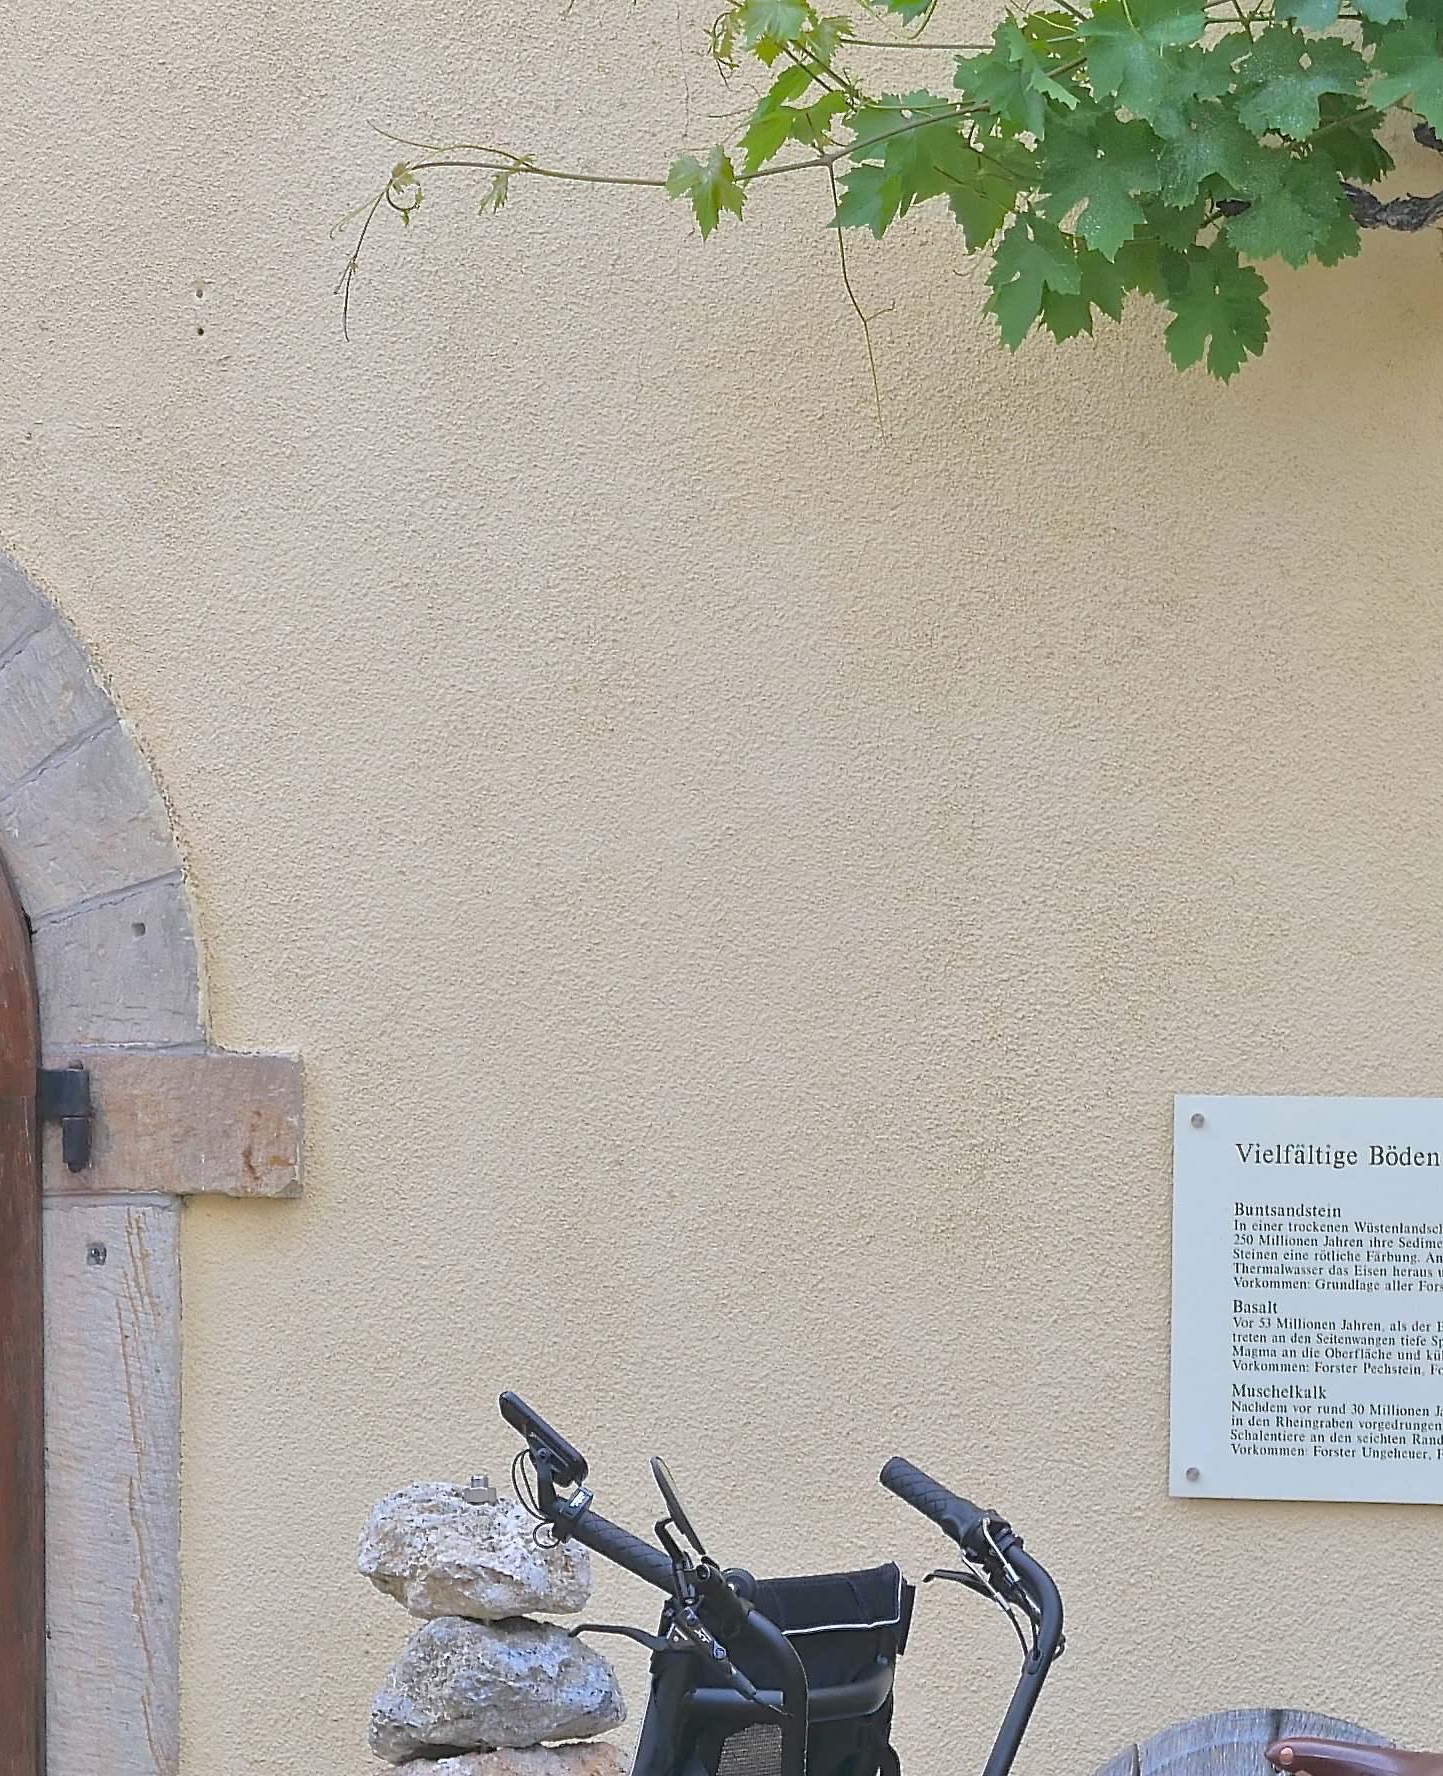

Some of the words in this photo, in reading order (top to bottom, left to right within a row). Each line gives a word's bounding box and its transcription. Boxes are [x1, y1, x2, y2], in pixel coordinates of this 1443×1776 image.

[1235, 1143, 1357, 1169] Vielfältige
[1369, 1145, 1440, 1166] Böden
[1233, 1202, 1341, 1218] Buntsandstein
[1234, 1219, 1246, 1231] In
[1252, 1220, 1283, 1231] einer
[1289, 1221, 1348, 1233] trockenen
[1234, 1234, 1253, 1245] 250
[1259, 1234, 1317, 1246] Millionen
[1323, 1235, 1363, 1247] Jahren
[1370, 1236, 1393, 1248] ihre
[1233, 1248, 1277, 1260] Steinen
[1283, 1249, 1308, 1261] eine
[1315, 1250, 1360, 1262] rötliche
[1367, 1251, 1420, 1265] Färbung.
[1426, 1252, 1443, 1263] An
[1233, 1262, 1324, 1275] Thermalwasser
[1329, 1265, 1348, 1276] das
[1355, 1265, 1386, 1277] Eisen
[1393, 1266, 1432, 1277] heraus
[1315, 1278, 1380, 1292] Grundlage
[1385, 1280, 1413, 1291] aller
[1233, 1299, 1277, 1314] Basalt
[1233, 1316, 1254, 1328] Vor
[1259, 1317, 1271, 1328] 53
[1277, 1318, 1335, 1330] Millionen
[1390, 1320, 1406, 1331] als
[1411, 1321, 1431, 1332] der
[1233, 1332, 1266, 1343] treten
[1272, 1335, 1285, 1343] an
[1290, 1333, 1311, 1344] den
[1316, 1333, 1395, 1347] Seitenwangen
[1401, 1335, 1426, 1346] tiefe
[1233, 1345, 1276, 1358] Magma
[1282, 1349, 1296, 1358] an
[1302, 1347, 1320, 1358] die
[1325, 1347, 1392, 1360] Oberfläche
[1397, 1350, 1420, 1361] und
[1315, 1361, 1357, 1374] Forster
[1232, 1384, 1326, 1399] Muschelkalk
[1232, 1401, 1287, 1414] Nachdem
[1293, 1405, 1311, 1414] vor
[1318, 1403, 1345, 1414] rund
[1351, 1403, 1364, 1415] 30
[1370, 1404, 1429, 1417] Millionen
[1232, 1415, 1243, 1426] in
[1248, 1415, 1269, 1426] den
[1274, 1416, 1353, 1430] Rheingraben
[1359, 1419, 1442, 1433] vorgedrungen
[1230, 1429, 1305, 1442] Schalentiere
[1310, 1434, 1324, 1443] an
[1330, 1432, 1351, 1443] den
[1357, 1433, 1406, 1444] seichten
[1314, 1445, 1356, 1457] Forster
